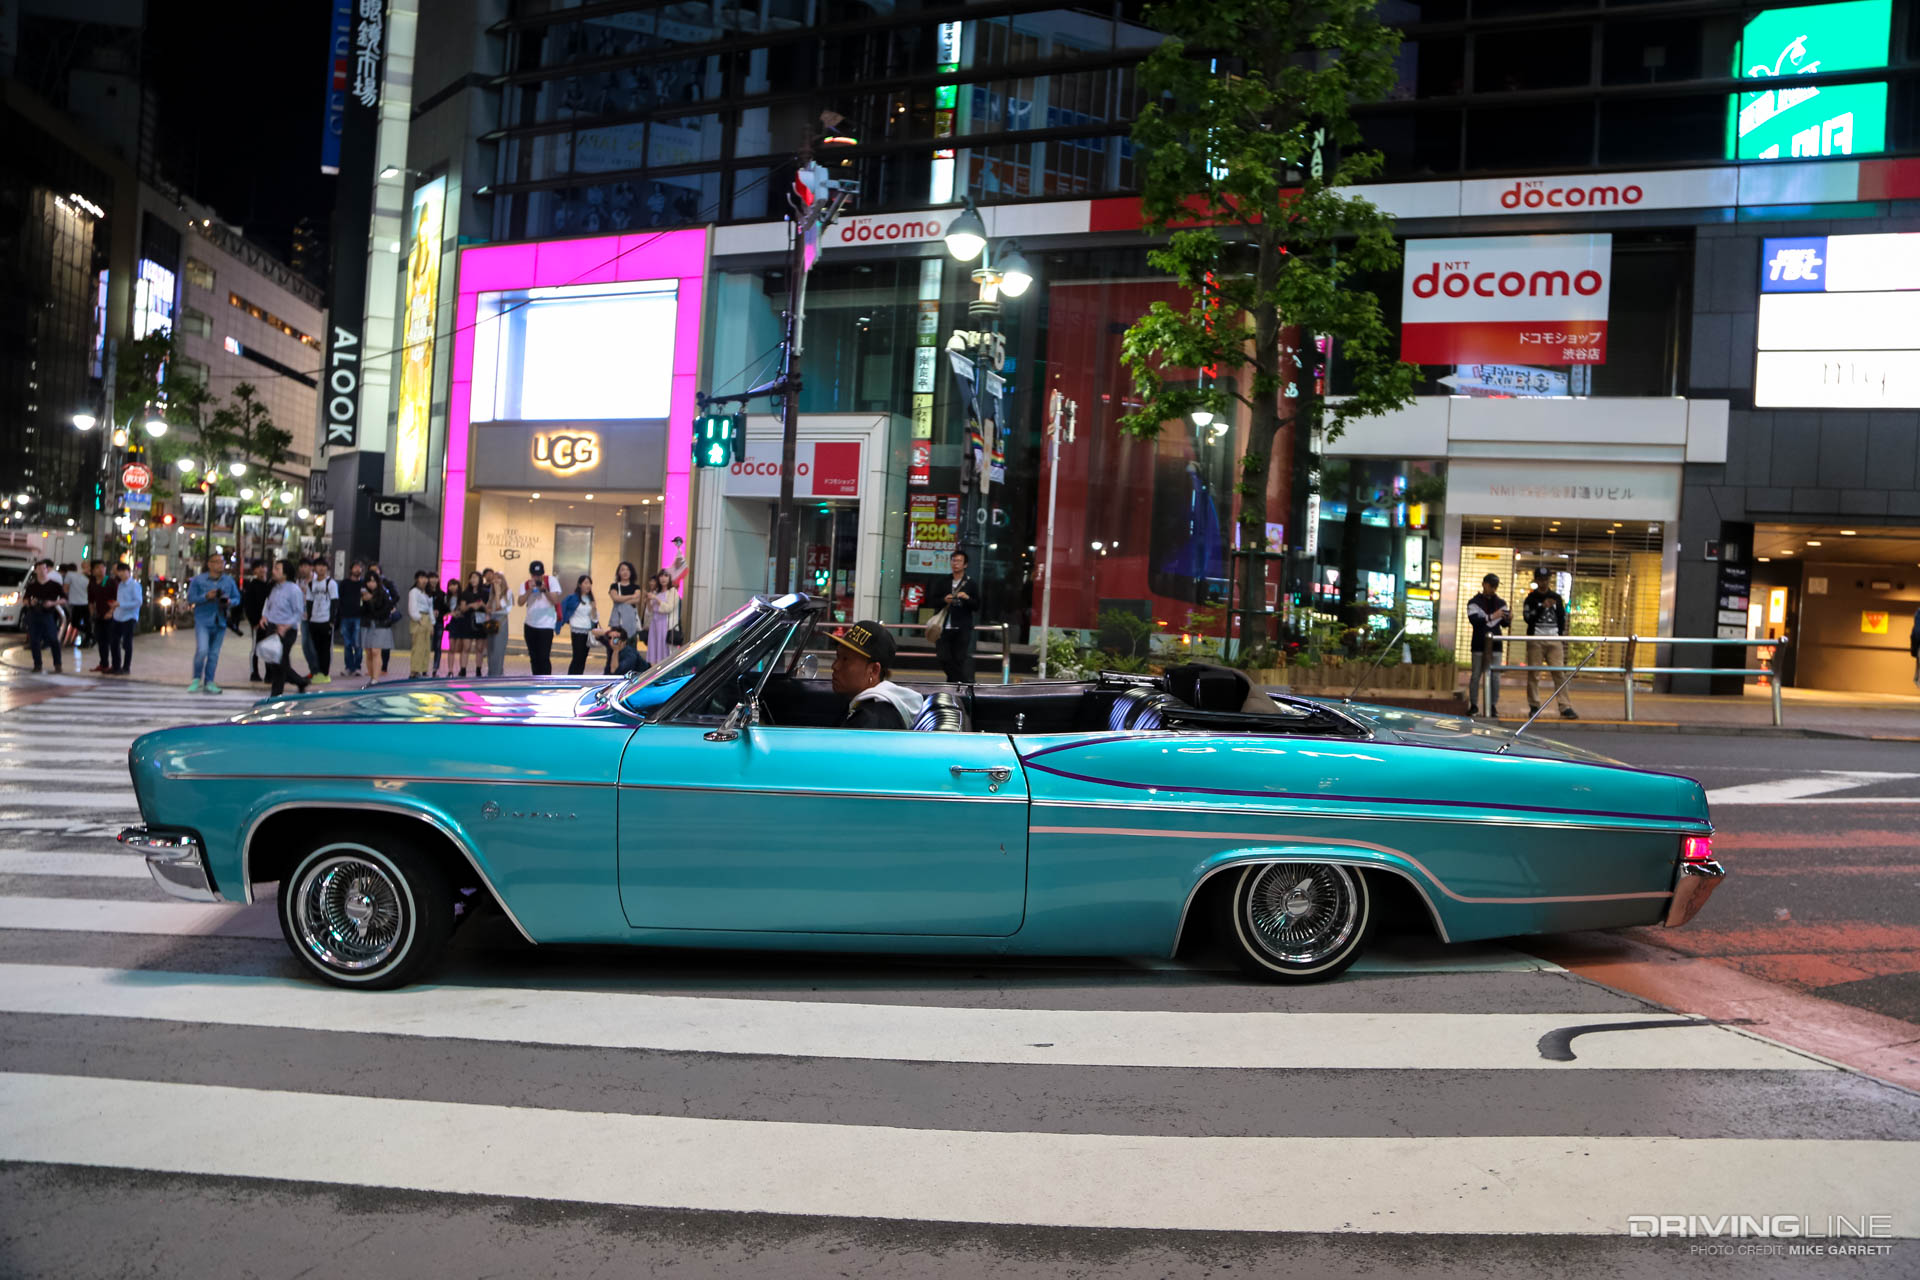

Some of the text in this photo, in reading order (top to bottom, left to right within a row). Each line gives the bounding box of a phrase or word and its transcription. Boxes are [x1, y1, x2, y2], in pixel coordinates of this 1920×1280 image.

[1500, 182, 1643, 209] docomo
[841, 219, 941, 242] docomo
[1444, 261, 1471, 270] NTT
[1412, 262, 1603, 299] docomo
[1519, 331, 1602, 345] ドコモショップ
[1562, 348, 1600, 360] 渋谷店
[328, 326, 358, 443] ALOOK
[533, 435, 593, 469] UGG
[730, 461, 810, 476] docoo
[375, 502, 400, 516] UGG
[499, 548, 521, 560] UGG
